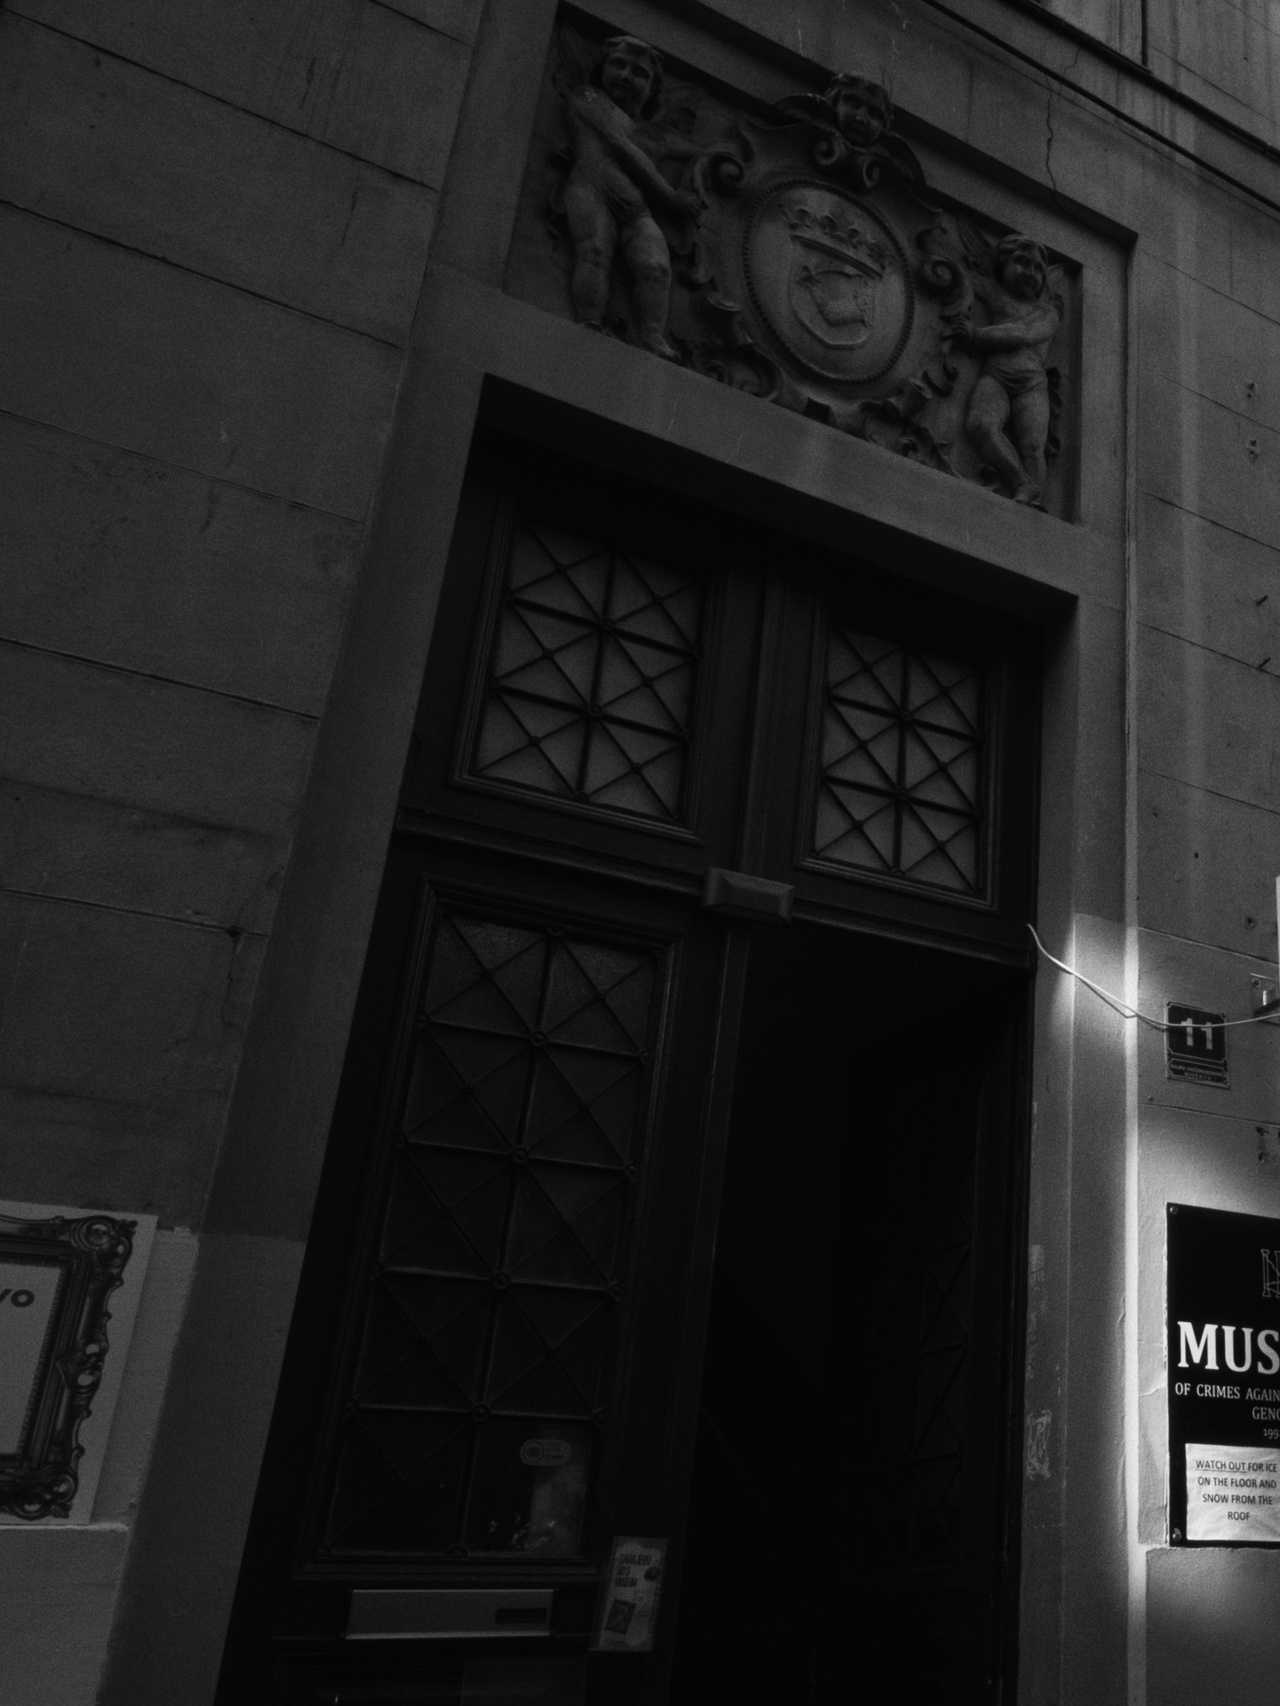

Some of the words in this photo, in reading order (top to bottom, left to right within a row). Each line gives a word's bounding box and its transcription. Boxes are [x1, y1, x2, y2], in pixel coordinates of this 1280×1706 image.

[1181, 1017, 1213, 1050] 11
[1175, 1382, 1191, 1396] OF
[1196, 1384, 1240, 1399] CRIMES
[1196, 1460, 1226, 1470] WATCH
[1228, 1461, 1246, 1471] OUT
[1248, 1462, 1264, 1472] FOR
[1265, 1463, 1277, 1473] ICE
[1197, 1476, 1210, 1486] ON
[1213, 1477, 1228, 1487] THE
[1230, 1478, 1257, 1488] FLOOR
[1259, 1479, 1277, 1489] AND
[1202, 1494, 1229, 1503] SNOW
[1231, 1494, 1256, 1505] FROM
[1258, 1495, 1273, 1505] THE
[1228, 1511, 1250, 1521] ROOF
